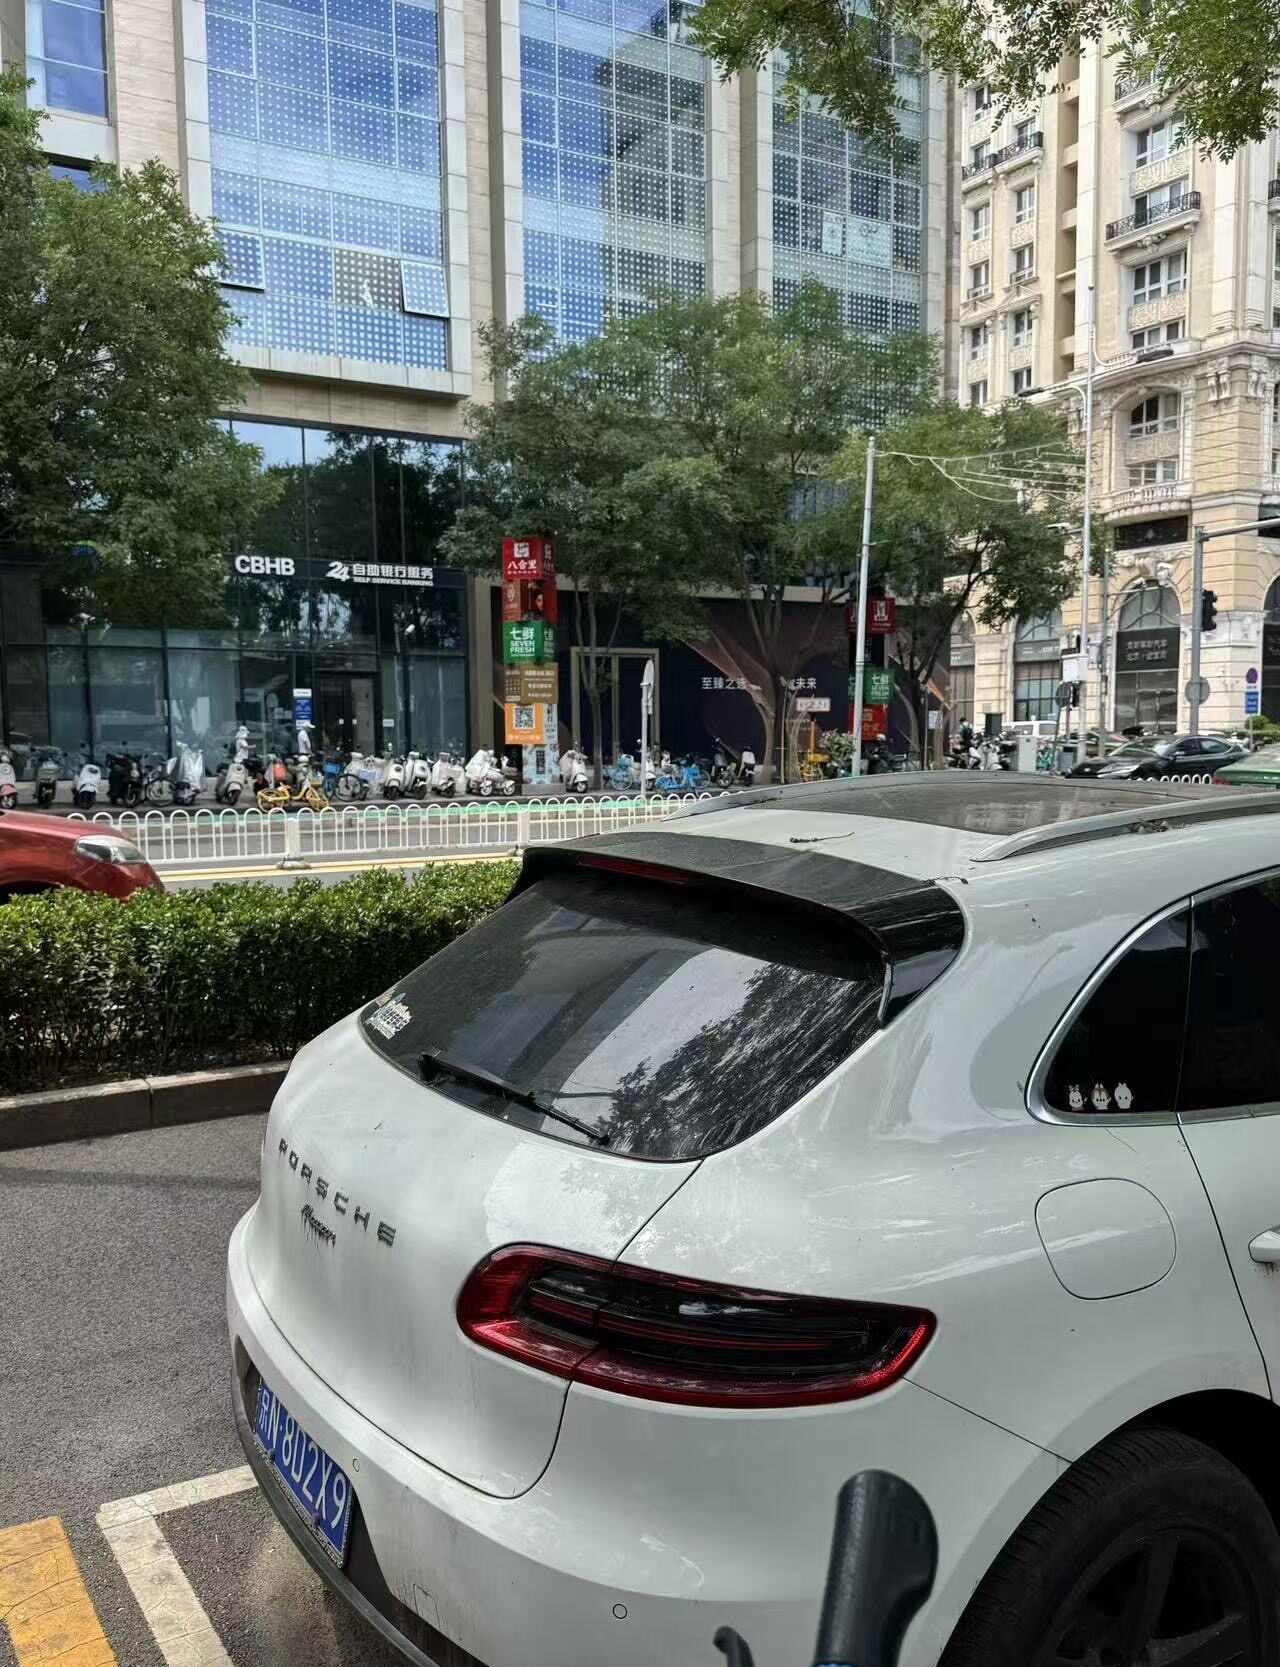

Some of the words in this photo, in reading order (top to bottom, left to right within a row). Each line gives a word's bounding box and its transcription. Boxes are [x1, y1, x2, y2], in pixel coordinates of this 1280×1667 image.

[234, 555, 295, 576] CBHB
[326, 561, 350, 582] 24
[352, 563, 433, 579] 自助银行服务
[507, 560, 537, 570] 八合里
[279, 1138, 397, 1248] PORSCHE
